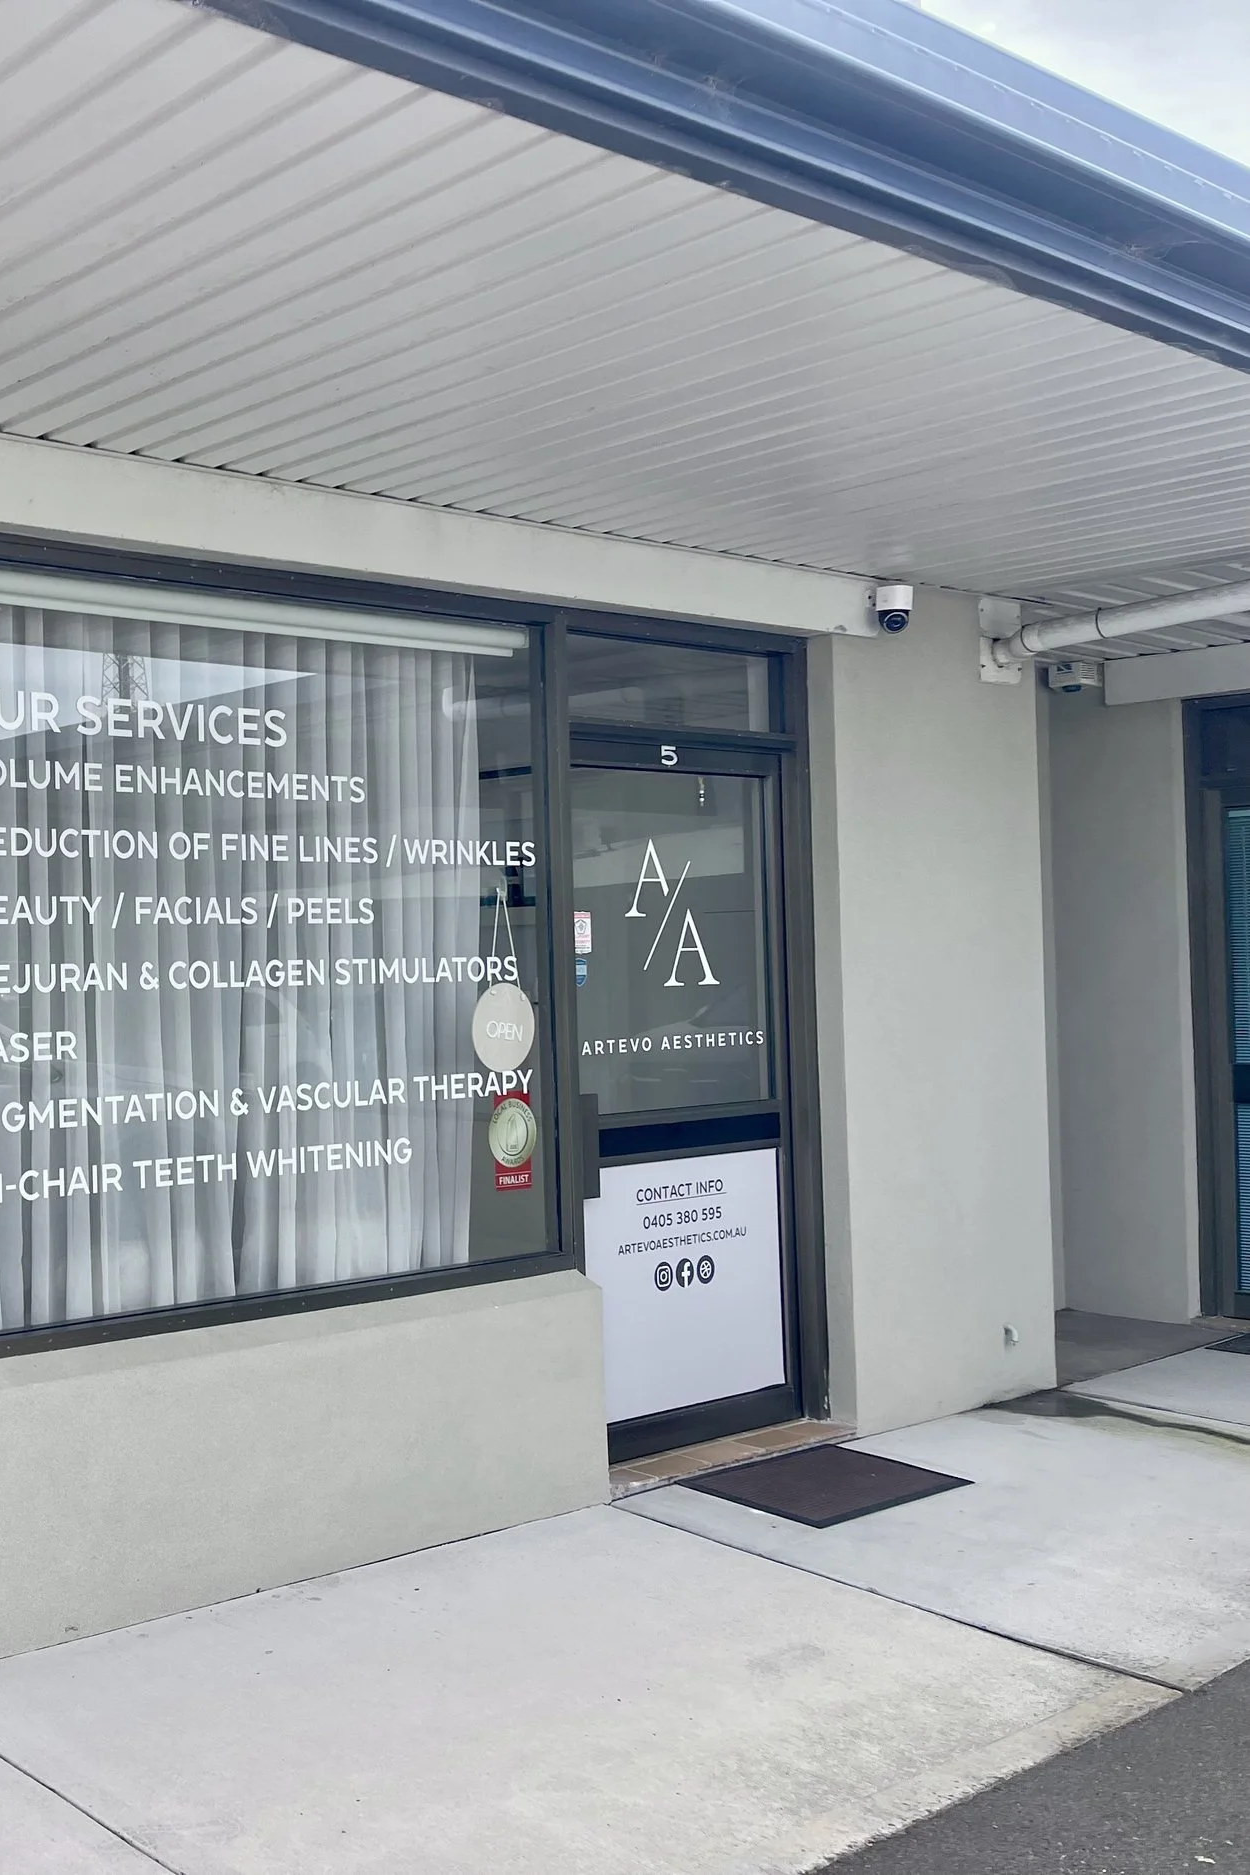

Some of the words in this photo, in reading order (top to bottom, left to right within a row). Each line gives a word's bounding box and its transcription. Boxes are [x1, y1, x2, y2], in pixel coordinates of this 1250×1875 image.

[76, 695, 287, 747] SERVICES
[661, 745, 678, 766] 5
[115, 764, 366, 803] ENHANCEMENTS
[168, 831, 211, 860] OF
[221, 834, 289, 862] FINE
[299, 835, 378, 864] LINES
[385, 834, 397, 868] /
[404, 838, 536, 867] WRINKLES
[111, 892, 125, 929] /
[135, 896, 257, 925] FACIALS
[267, 893, 279, 928] /
[287, 897, 375, 925] PEELS
[139, 961, 159, 990] &
[168, 958, 325, 990] COLLAGEN
[335, 955, 518, 986] STIMULATORS
[486, 1020, 523, 1042] OPEN
[581, 1036, 652, 1056] ARTEVO
[660, 1030, 764, 1051] AESTHETICS
[230, 1088, 249, 1116] &
[257, 1077, 406, 1114] VASCULAR
[413, 1068, 533, 1102] THERAPY
[492, 1103, 508, 1124] LOCAL
[508, 1101, 533, 1122] BUSINESS
[133, 1152, 237, 1189] TEETH
[246, 1137, 413, 1178] WHITENING
[501, 1156, 525, 1166] AWARDS
[499, 1174, 530, 1186] FINALIST
[636, 1182, 692, 1203] CONTACT
[696, 1178, 724, 1195] INFO
[643, 1213, 673, 1230] 0405
[676, 1209, 698, 1225] 380
[701, 1206, 722, 1222] 595
[618, 1226, 747, 1256] ARTEVOAESTHETICS.COM.AU
